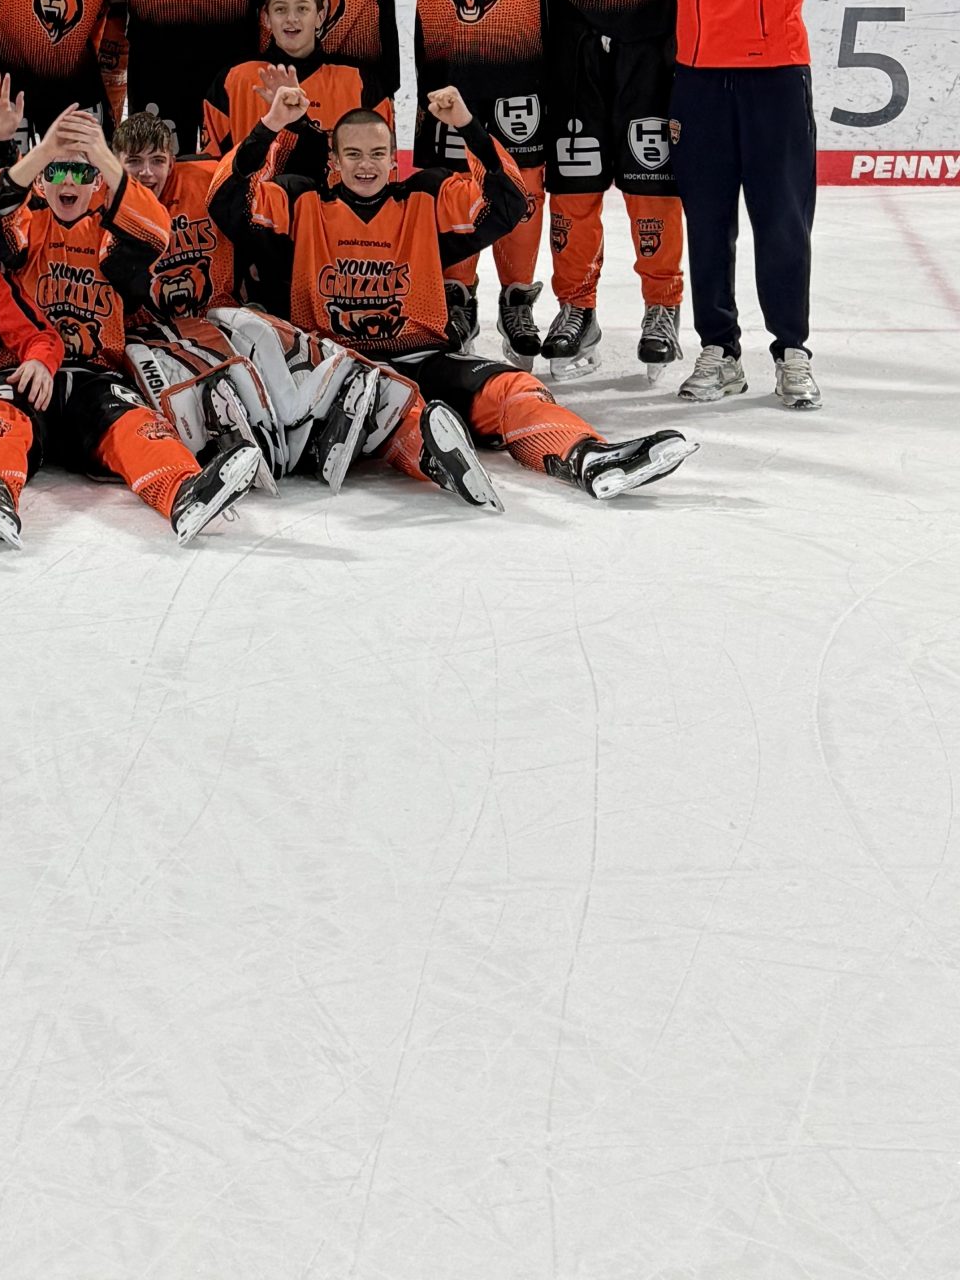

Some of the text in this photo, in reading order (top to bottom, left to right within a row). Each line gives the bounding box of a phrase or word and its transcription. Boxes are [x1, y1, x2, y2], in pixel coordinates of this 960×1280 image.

[830, 7, 910, 128] 5
[851, 155, 960, 179] PENNY
[319, 264, 410, 298] GRIZZLYS
[336, 258, 394, 276] YOUNG
